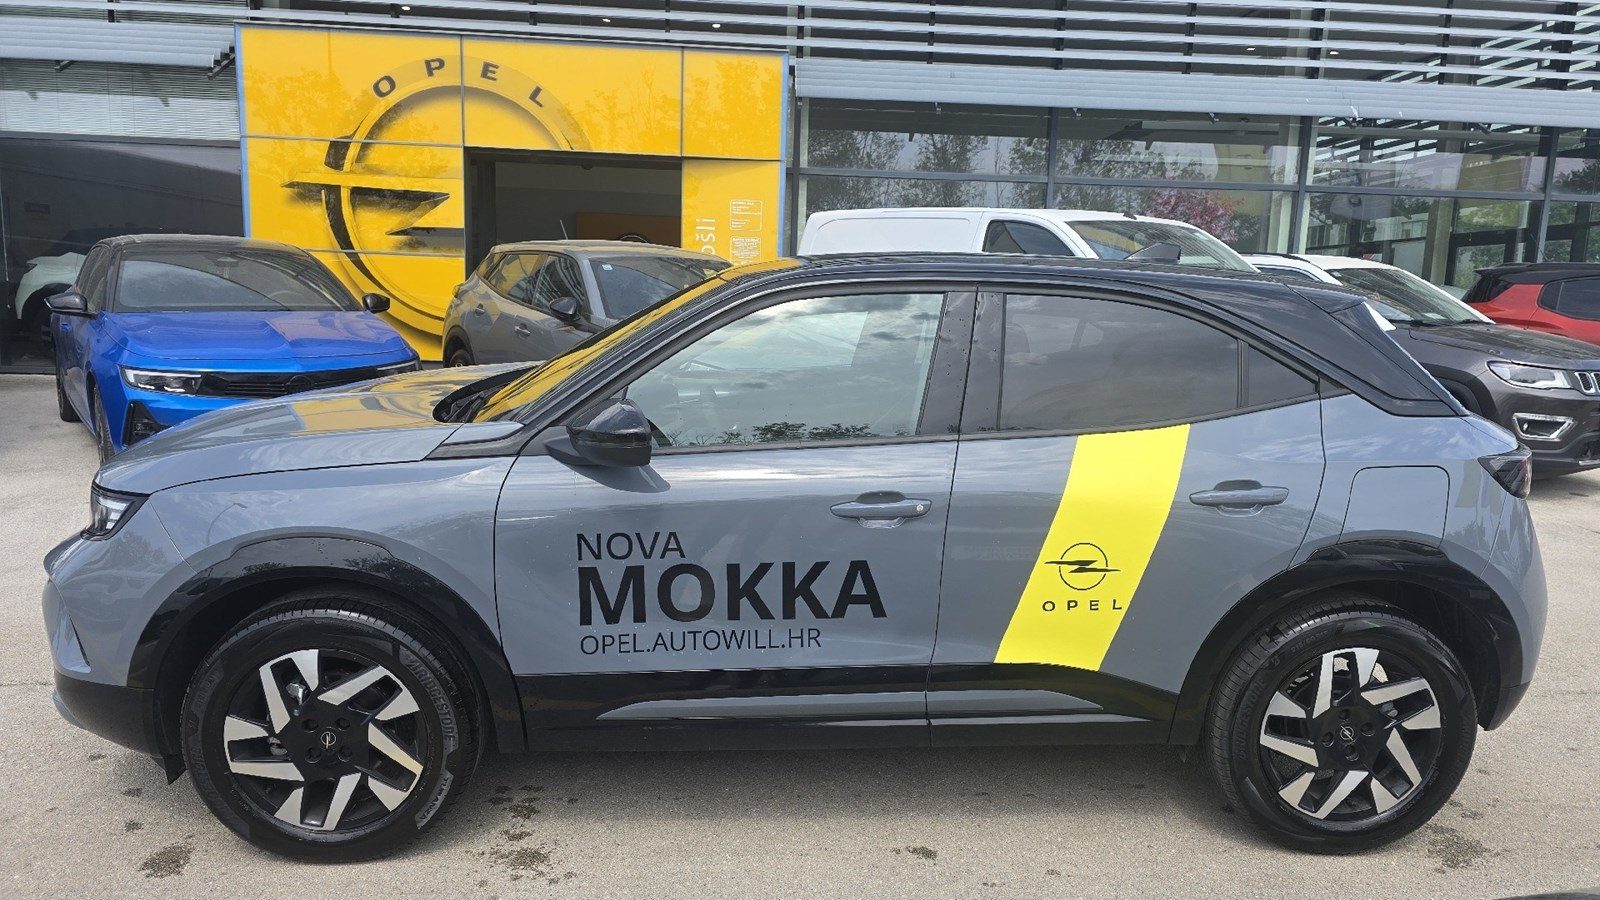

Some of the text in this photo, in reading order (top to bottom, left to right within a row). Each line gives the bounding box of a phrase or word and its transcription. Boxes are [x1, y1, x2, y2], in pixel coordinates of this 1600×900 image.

[372, 57, 544, 108] OPEL
[576, 531, 686, 561] NOVA
[577, 560, 888, 626] MOKKA
[1042, 599, 1122, 612] OPEL
[580, 628, 822, 655] OPEL.AUTOWILL.HR
[406, 654, 457, 745] BRIDGESTONE
